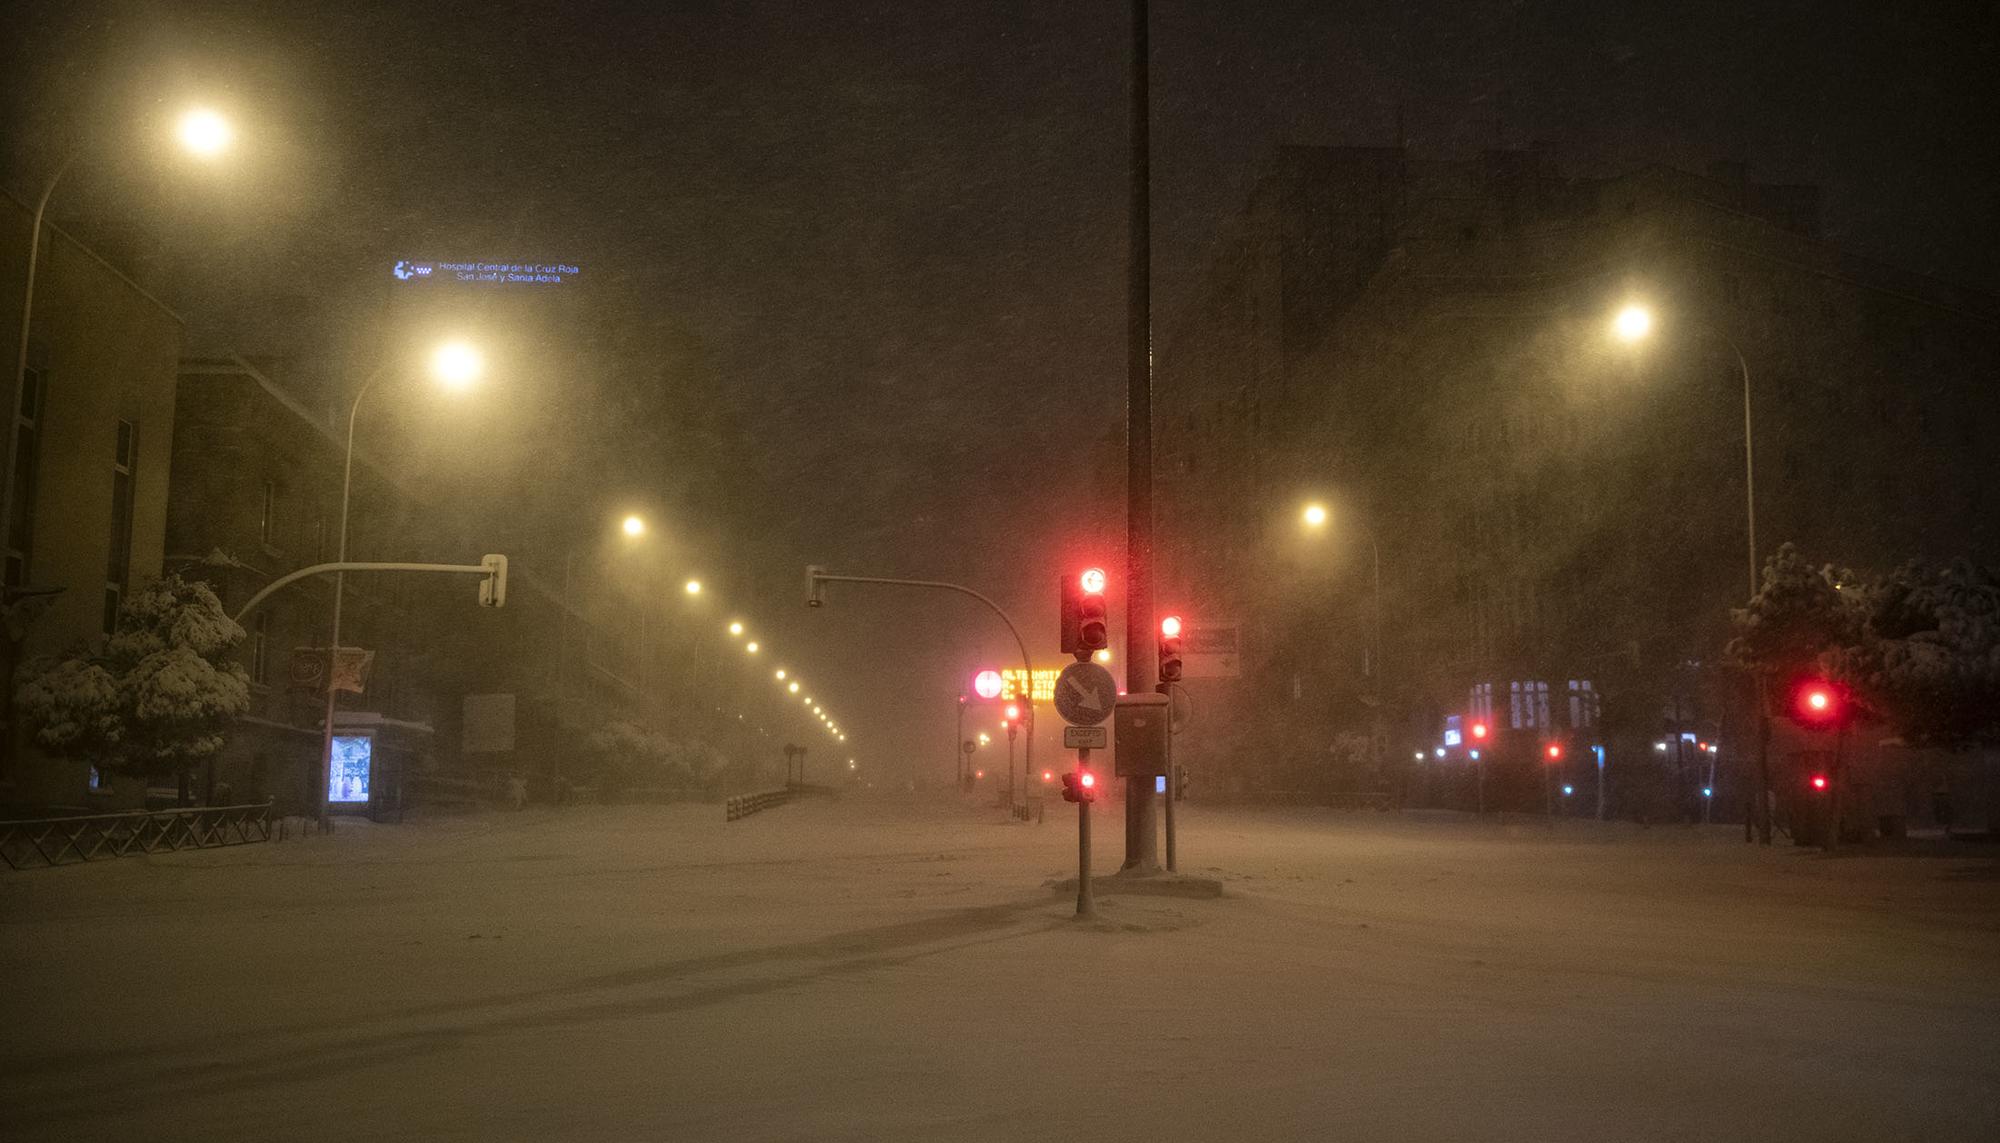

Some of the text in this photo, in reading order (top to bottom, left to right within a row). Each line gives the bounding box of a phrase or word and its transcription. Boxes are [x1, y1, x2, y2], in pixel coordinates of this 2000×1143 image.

[439, 262, 579, 274] Hospital Central de la Cruz Roja
[456, 272, 475, 281] San
[476, 272, 498, 281] José
[507, 273, 533, 282] Santa
[535, 274, 561, 283] Adela
